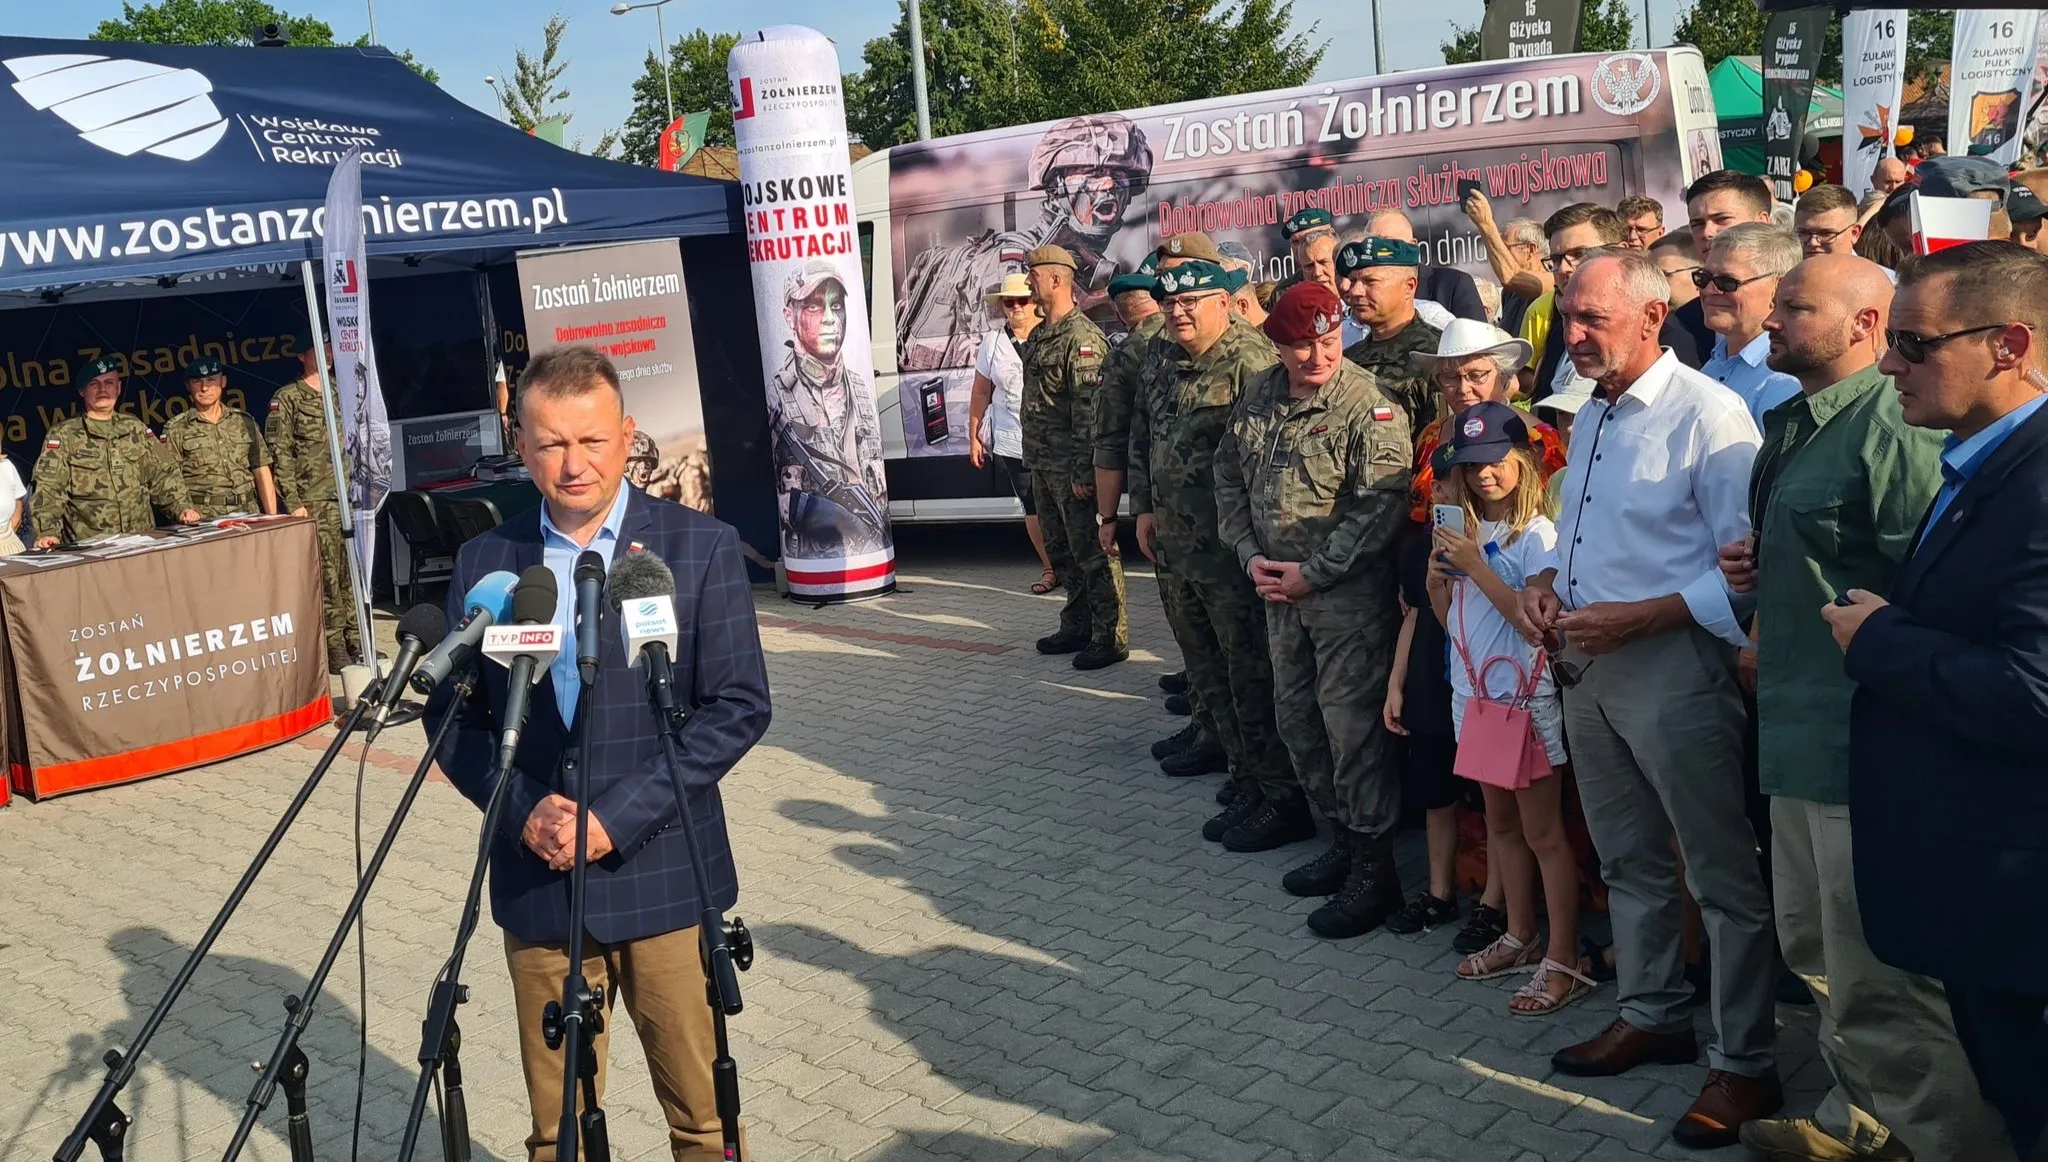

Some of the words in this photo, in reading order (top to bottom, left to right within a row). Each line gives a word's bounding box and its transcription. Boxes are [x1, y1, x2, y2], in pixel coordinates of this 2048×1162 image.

[1525, 0, 1536, 17] 15
[1509, 19, 1552, 39] Giżycka
[1788, 22, 1797, 35] 15
[1874, 19, 1896, 40] 16
[1988, 21, 2014, 39] 16
[1508, 39, 1553, 58] Brygada
[1971, 46, 2025, 58] ŻUŁAWSKI
[1961, 66, 2033, 80] LOGISTYCZNY
[1984, 58, 2011, 68] PUŁK
[761, 84, 837, 100] ŻOŁNIERZEM
[250, 113, 383, 137] Wojskowe
[1163, 101, 1304, 162] Zostań
[1317, 73, 1581, 143] Żołnierzem
[262, 128, 376, 147] Centrum
[1985, 133, 2001, 145] 16
[271, 146, 403, 168] Rekruacji
[742, 174, 847, 207] OJSKOWE
[1158, 188, 1277, 238] Dobrowolna
[1281, 176, 1402, 222] zasadnicza
[1486, 147, 1608, 204] wojskowa
[0, 188, 568, 268] ww.zostanznierzem.pl
[1269, 247, 1295, 282] od
[1437, 229, 1488, 266] dnia
[531, 279, 590, 310] Zostań
[591, 272, 680, 303] Żołnierzem
[555, 320, 614, 343] Dobrowolna
[615, 315, 667, 335] zasadnicza
[609, 337, 657, 359] wojskowa
[635, 366, 652, 379] dnia
[651, 360, 673, 376] służby
[69, 613, 145, 643] ZOSTAŃ
[635, 618, 667, 629] polsat
[639, 626, 665, 635] news
[74, 612, 294, 682] ŻOŁNIERZEM
[520, 632, 553, 643] INFO
[81, 647, 298, 712] RZECZYPOSPOLITEJ
